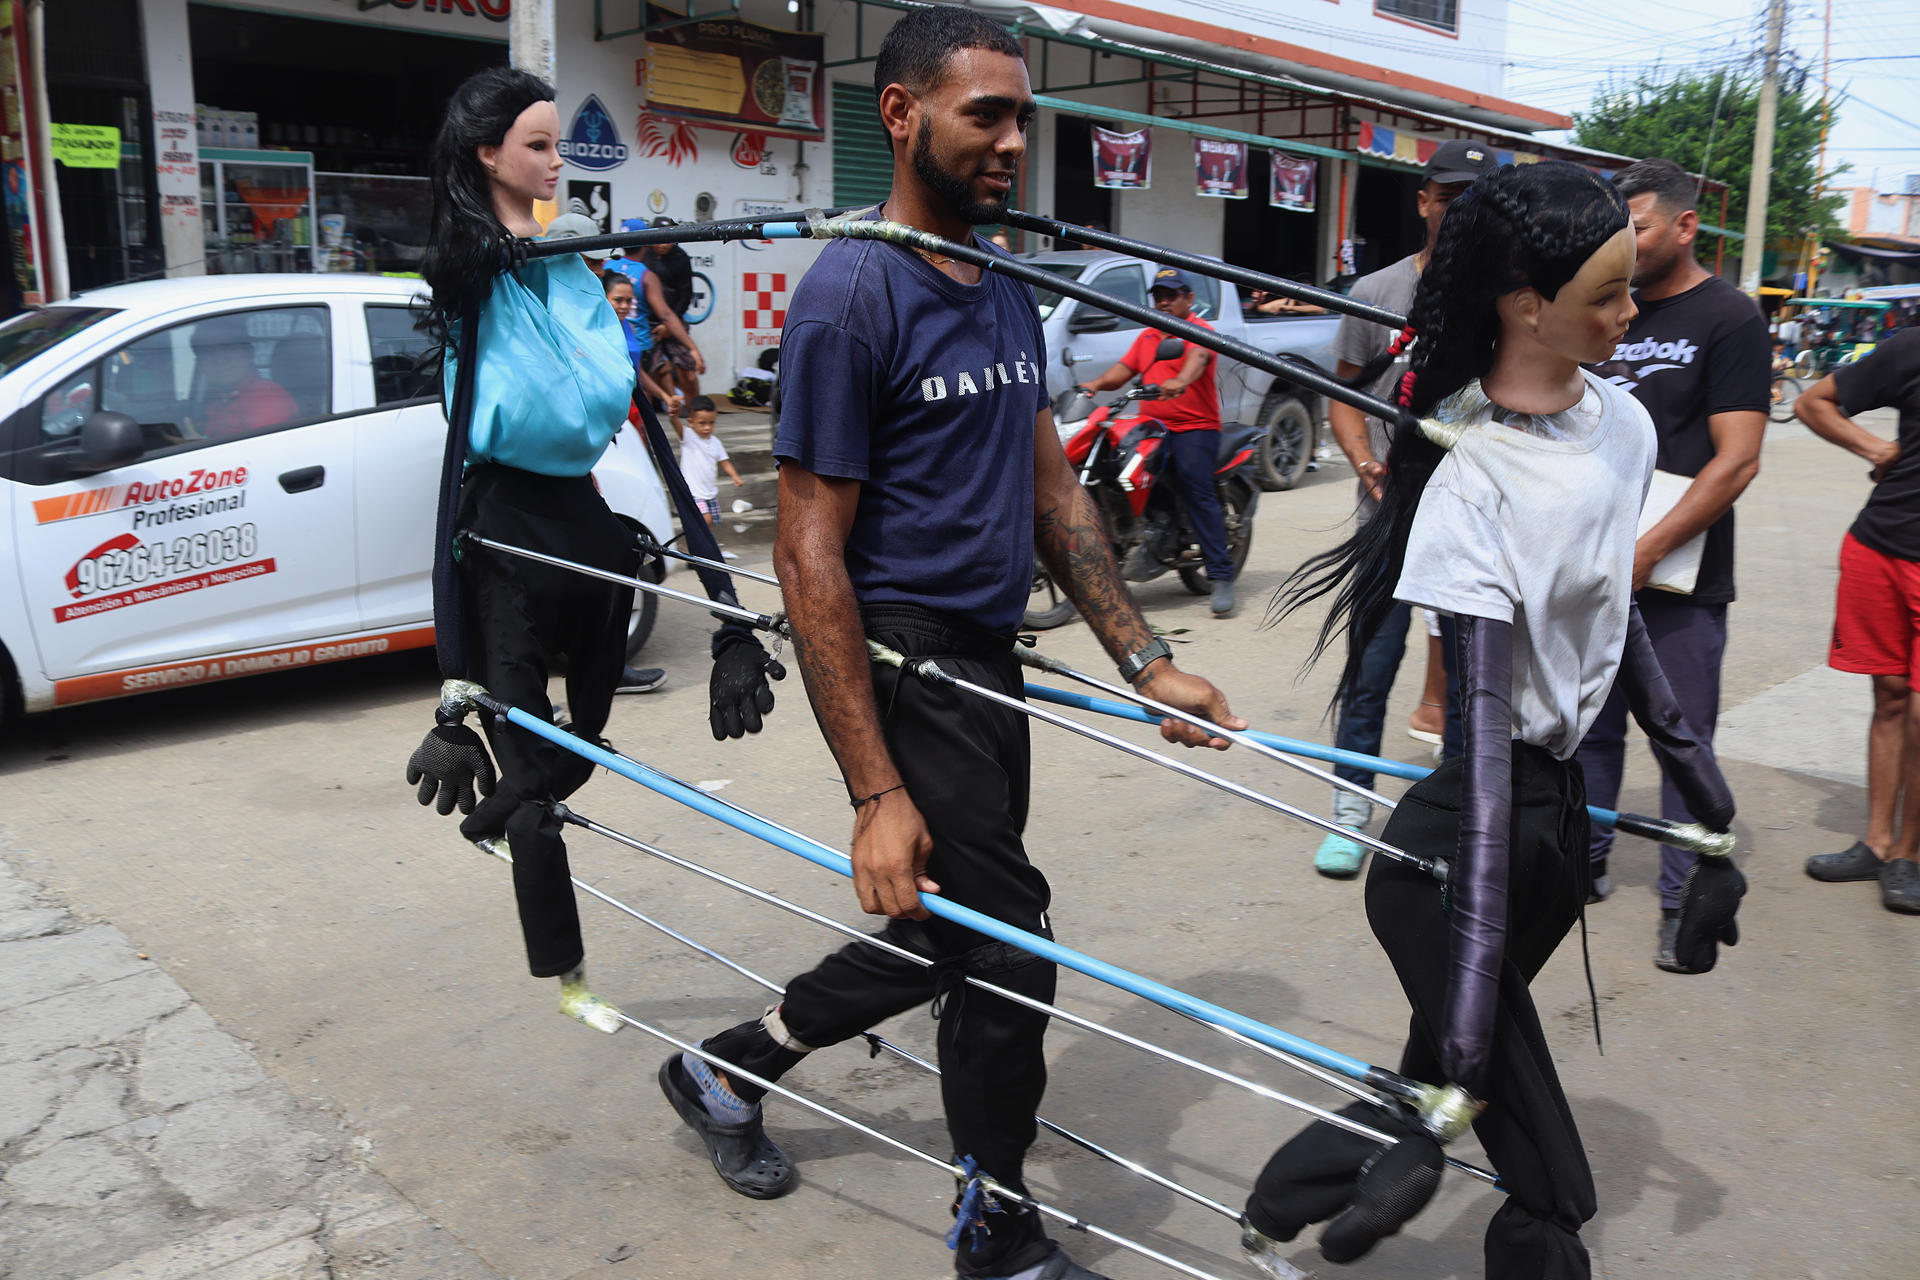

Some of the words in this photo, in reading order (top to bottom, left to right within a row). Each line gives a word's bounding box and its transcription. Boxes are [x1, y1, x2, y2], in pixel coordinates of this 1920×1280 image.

[559, 141, 627, 159] BIOZOO
[760, 163, 777, 175] Lab
[124, 466, 247, 507] AutoZone
[133, 490, 246, 530] Profesional
[77, 522, 258, 595] 96264-26038
[65, 597, 123, 618] Atención
[124, 595, 133, 604] a
[134, 582, 199, 601] Mecánicos
[200, 577, 209, 588] y
[210, 564, 266, 584] Negocios
[123, 665, 205, 690] SERVICIO
[208, 662, 221, 676] A
[225, 650, 310, 675] DOMICILIO
[314, 638, 389, 662] GRATUITO
